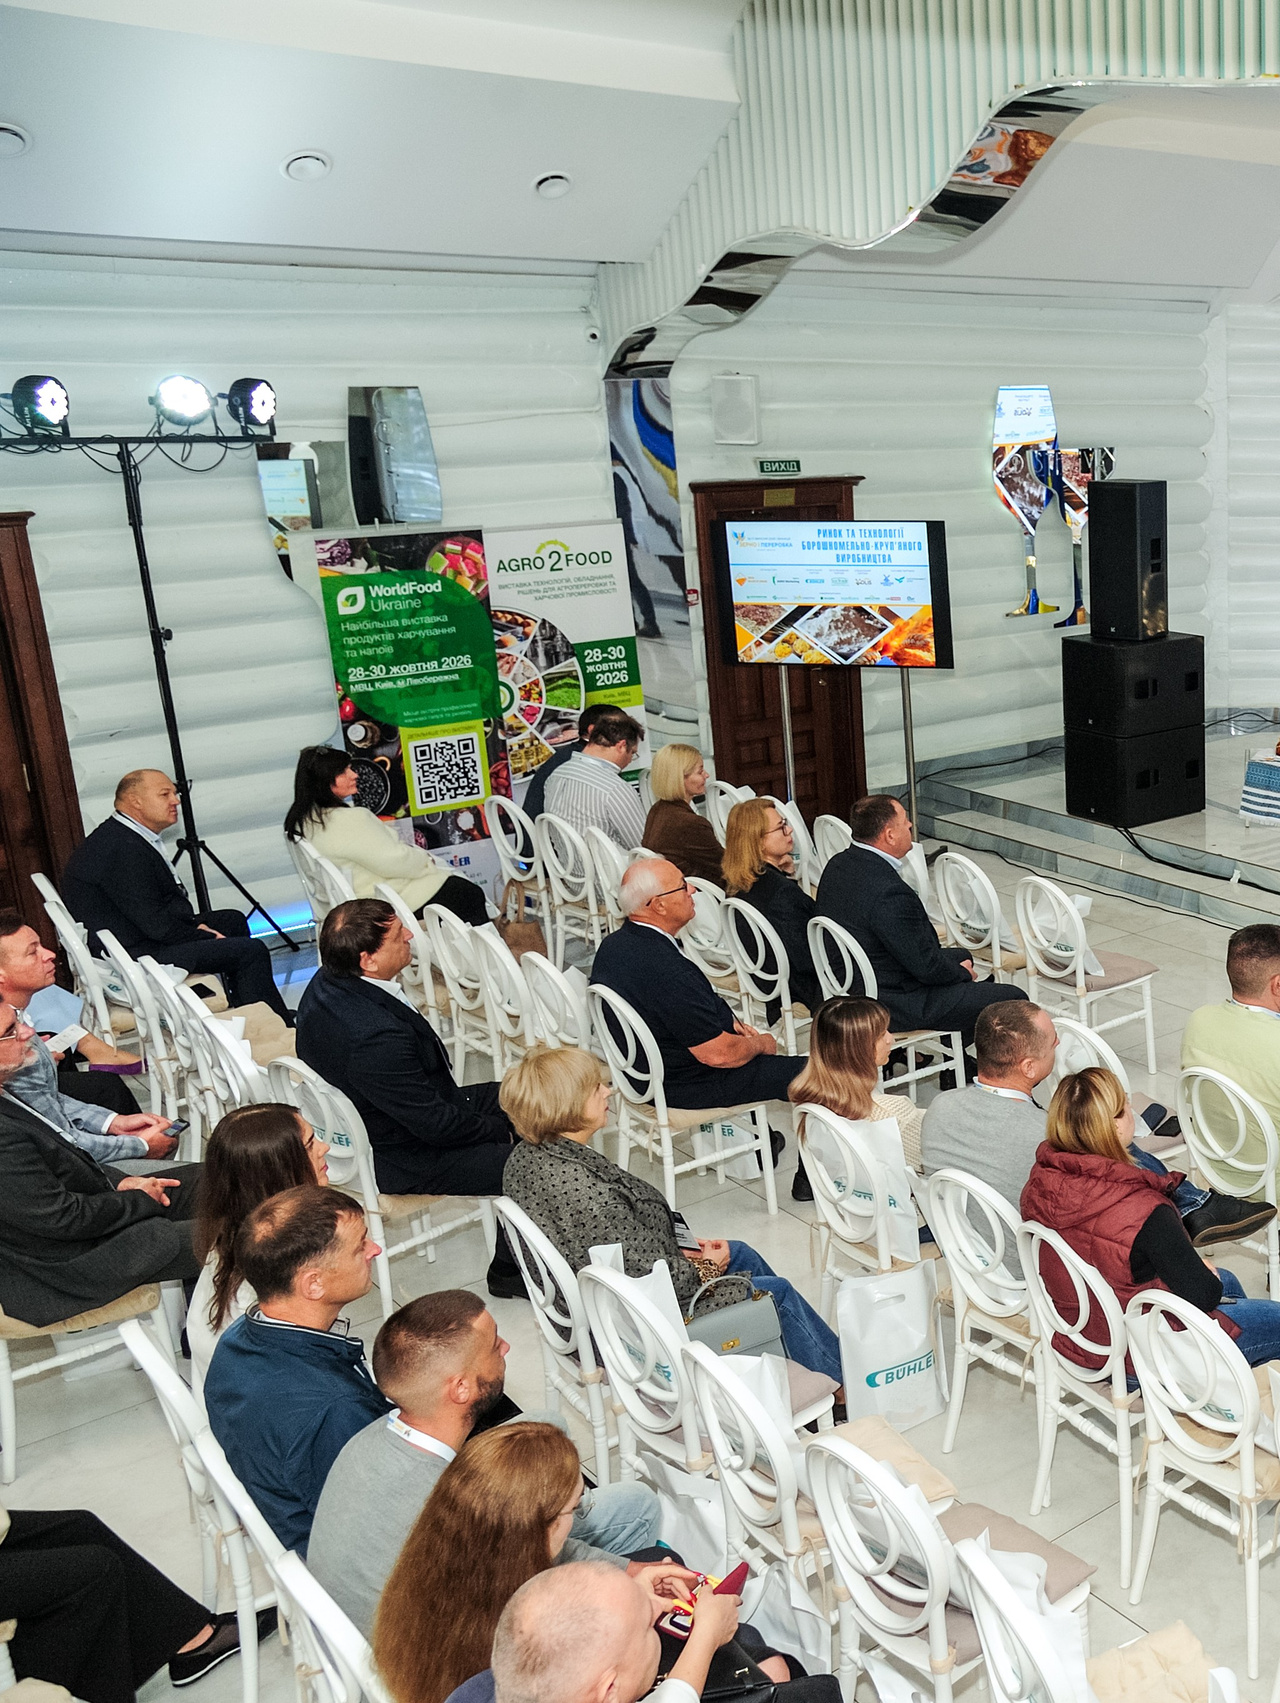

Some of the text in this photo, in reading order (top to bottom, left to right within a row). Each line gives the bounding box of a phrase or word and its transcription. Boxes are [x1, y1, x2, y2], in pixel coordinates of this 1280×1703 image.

[764, 462, 798, 472] ВИХІД
[818, 527, 904, 538] РИНОК ТА ТЕХНОЛОГІЇ
[836, 554, 892, 564] ВИРОБНИЦТВА
[369, 580, 442, 597] WorldFood
[498, 582, 531, 590] ВИСТАВКА
[557, 583, 608, 591] АГРОПЕРЕРОБКИ
[566, 588, 617, 597] ПРОМИСЛОВОСТІ
[370, 597, 422, 612] Ukraine
[341, 614, 448, 631] Найбільша виставка
[343, 626, 456, 645] продуктів харчування
[346, 645, 394, 658] та напоїв
[584, 645, 625, 662] 28-30
[348, 655, 471, 679] 28-30 жовтня 2026
[586, 661, 627, 673] жовтня
[596, 670, 628, 686] 2026
[885, 1354, 934, 1384] BÜHLE
